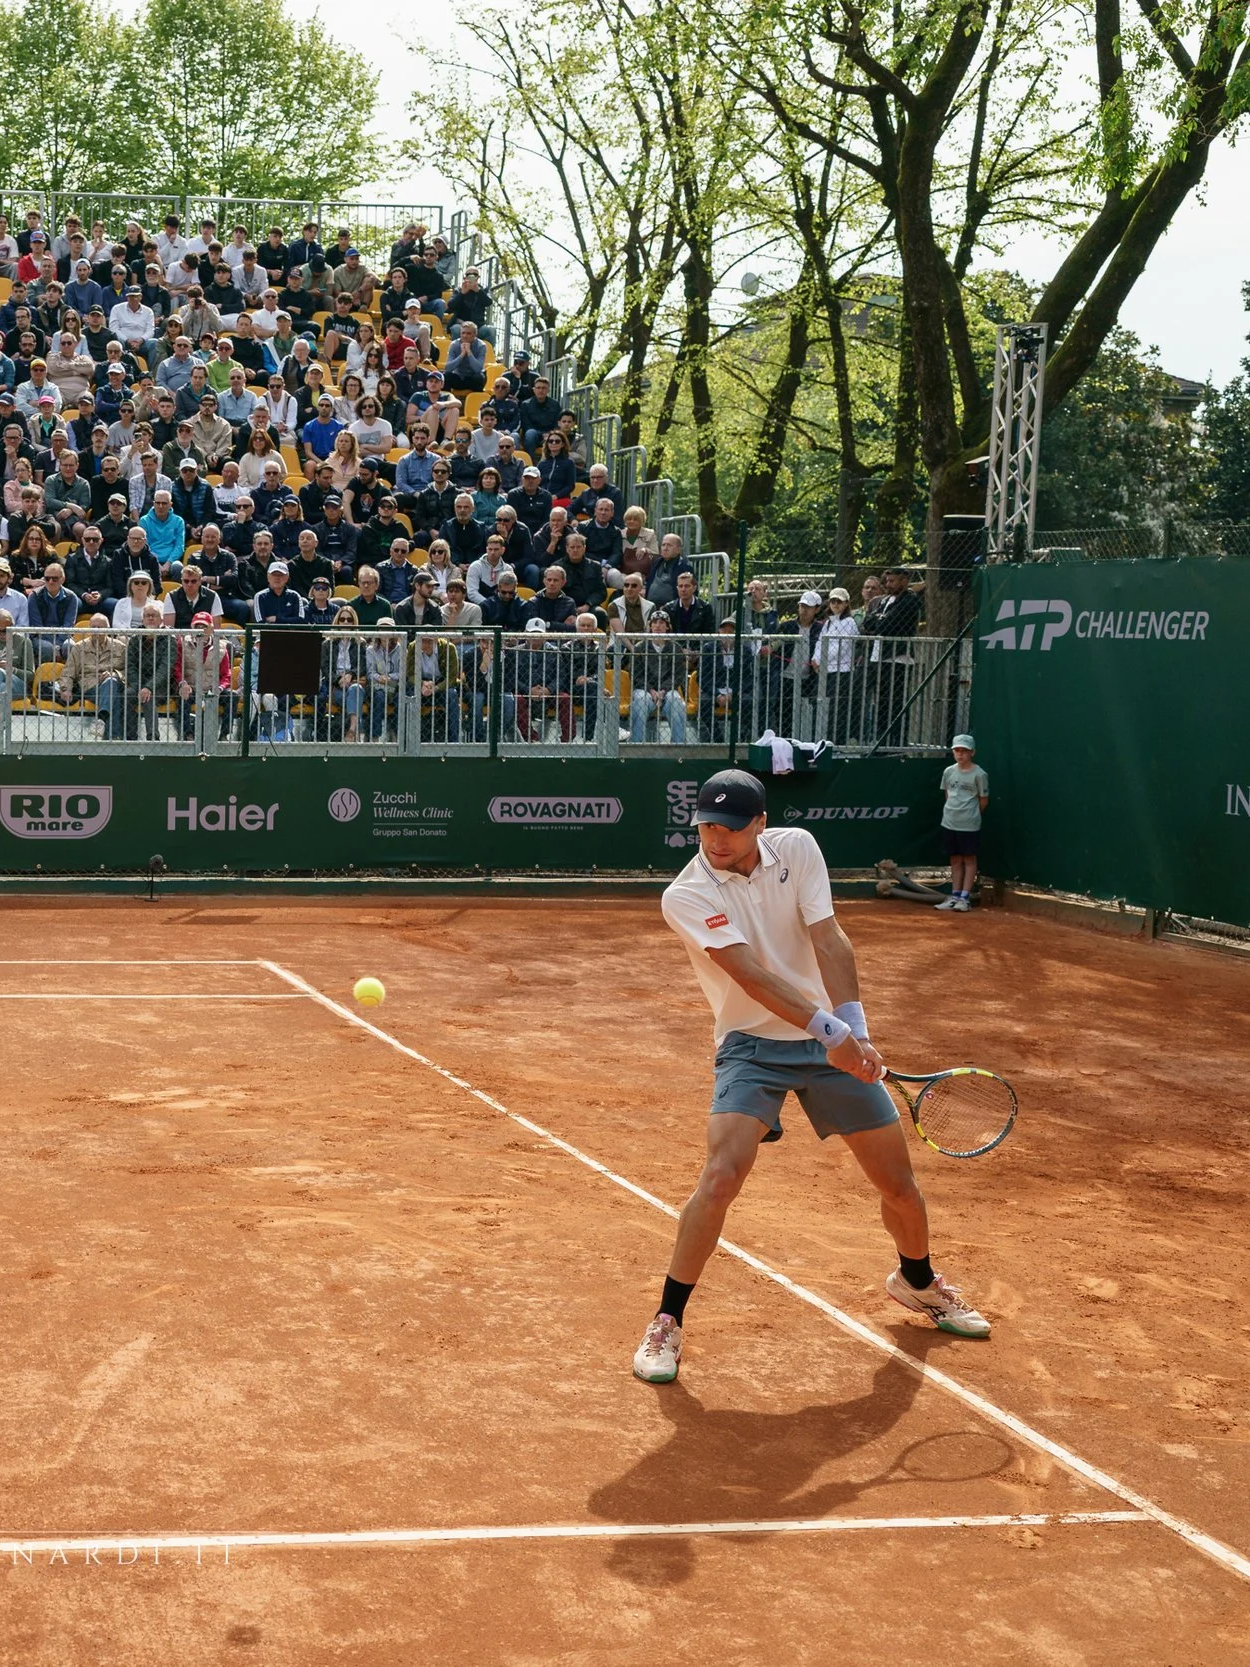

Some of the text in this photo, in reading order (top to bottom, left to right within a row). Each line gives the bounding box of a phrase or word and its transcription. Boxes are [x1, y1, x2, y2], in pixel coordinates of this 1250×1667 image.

[979, 600, 1209, 650] ATP CHALLENGER
[373, 792, 417, 804] Zucchi
[10, 794, 101, 819] RIO
[167, 795, 280, 831] Haier
[374, 807, 454, 818] Wellness Clinic
[500, 802, 610, 818] ROVAGNATI
[804, 807, 909, 820] DUNLOP
[26, 821, 84, 831] mare
[372, 828, 447, 837] Gruppo San Donato
